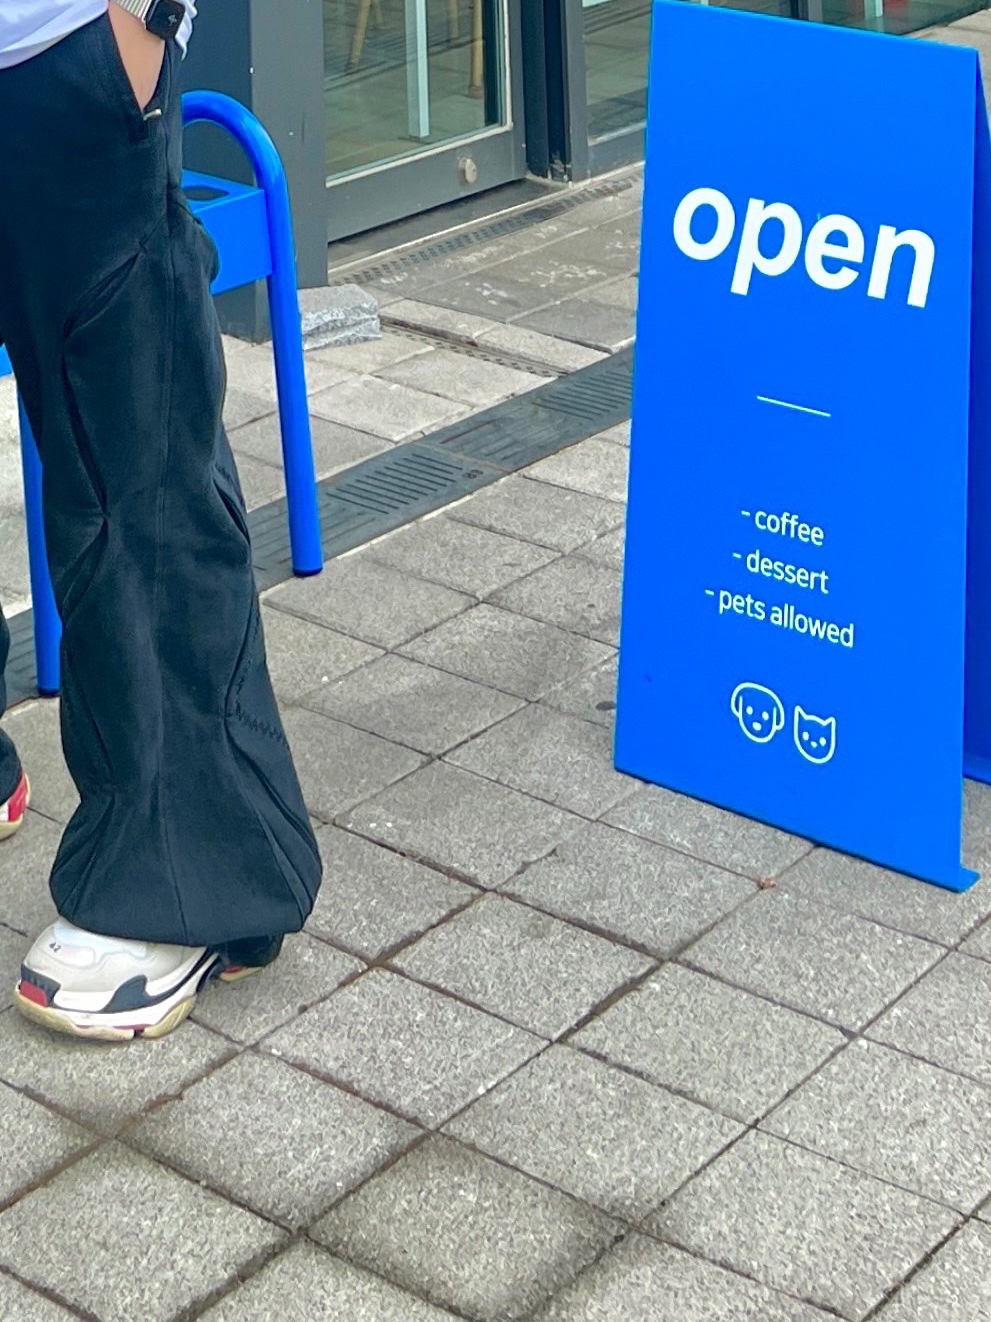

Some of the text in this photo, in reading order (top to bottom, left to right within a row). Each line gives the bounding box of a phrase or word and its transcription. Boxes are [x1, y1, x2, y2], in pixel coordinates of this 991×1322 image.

[672, 186, 937, 309] open
[755, 508, 824, 547] coffee
[746, 550, 829, 595] dessert
[719, 589, 765, 625] pets
[770, 600, 855, 648] allowed
